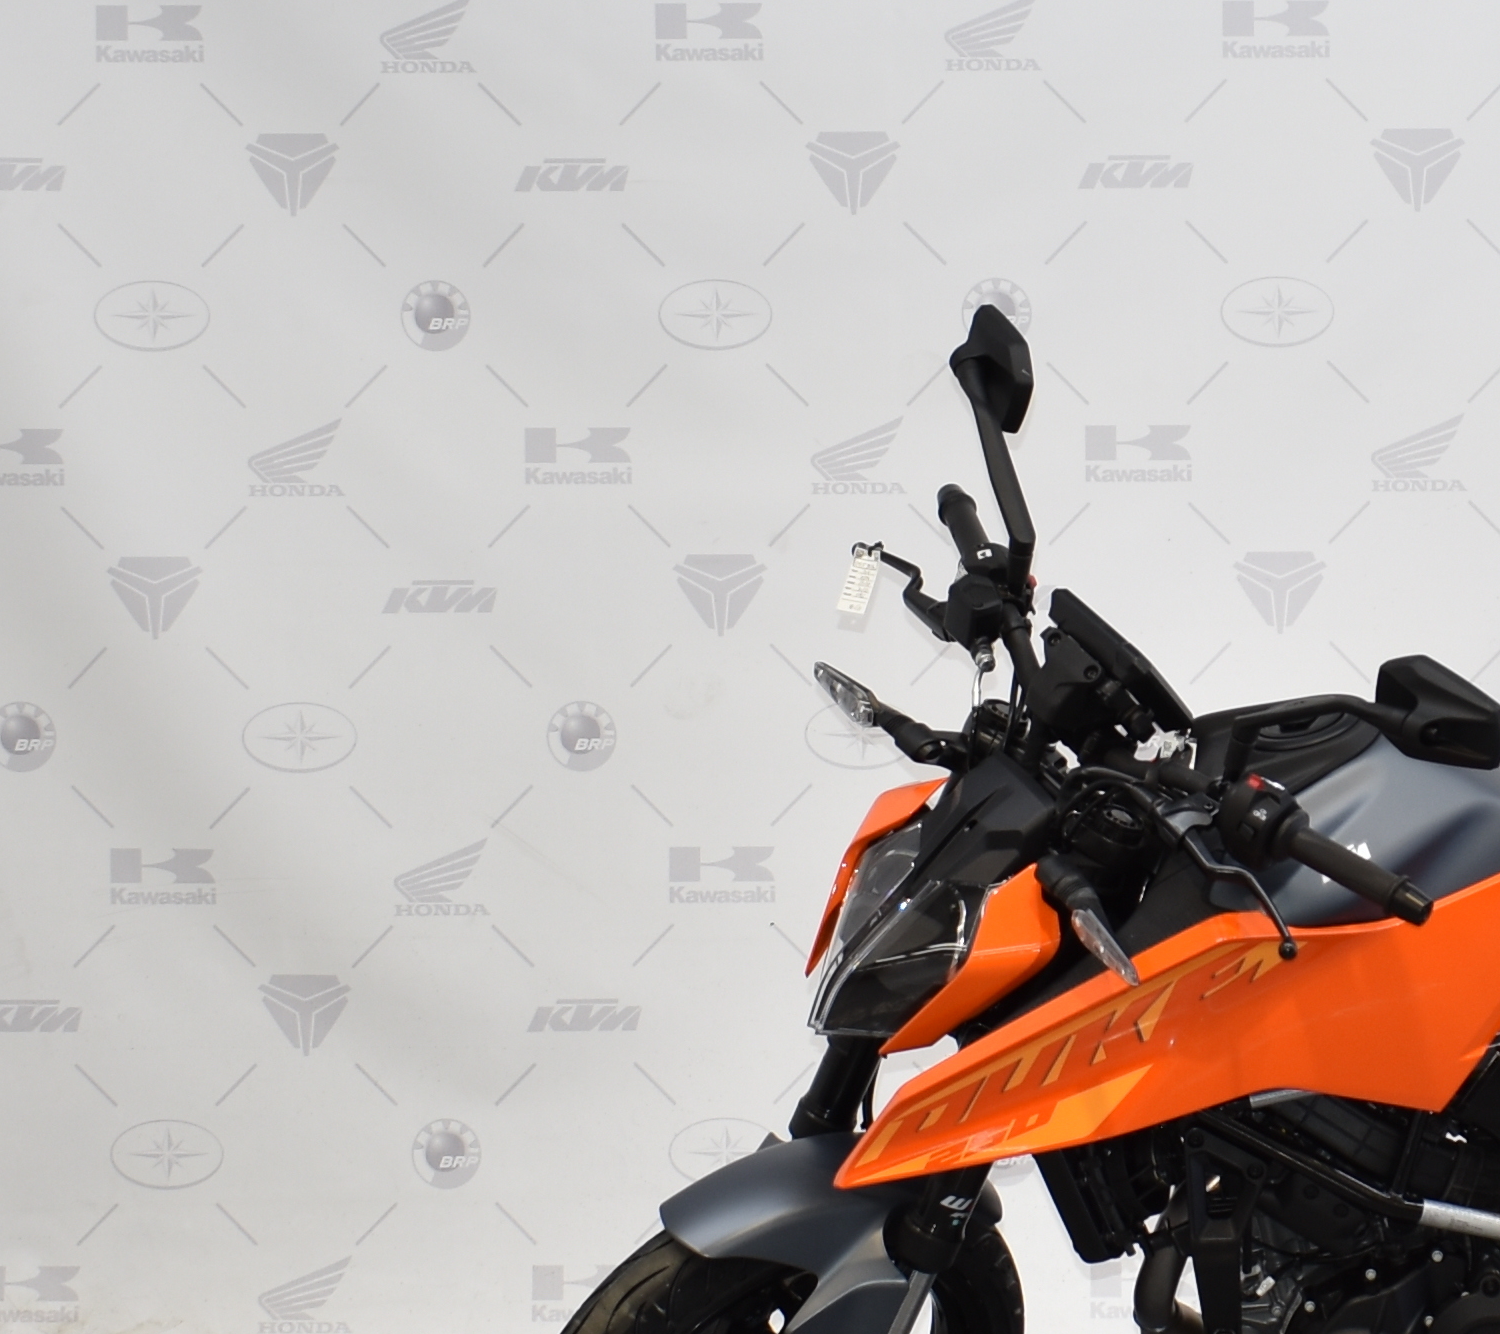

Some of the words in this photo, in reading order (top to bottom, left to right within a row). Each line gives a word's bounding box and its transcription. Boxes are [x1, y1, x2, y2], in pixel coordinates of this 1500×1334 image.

[96, 44, 204, 63] Kawasaki
[655, 43, 763, 61] Kawasaki
[1222, 41, 1330, 58] Kawasaki
[381, 58, 476, 73] HONDA
[946, 56, 1041, 71] HONDA
[514, 158, 628, 192] KTM
[1078, 155, 1193, 189] KTM
[525, 467, 632, 485] Kawasaki
[1085, 464, 1192, 482] Kawasaki
[249, 482, 345, 497] HONDA
[811, 479, 905, 495] HONDA
[1372, 477, 1467, 492] HONDA
[382, 580, 497, 613] KTM
[15, 738, 54, 751] BRP
[111, 884, 217, 905] Kawasaki
[668, 882, 775, 904] Kawasaki
[394, 901, 489, 917] HONDA
[526, 999, 640, 1033] KTM
[440, 1155, 479, 1168] BRP
[257, 1319, 351, 1334] HONDA
